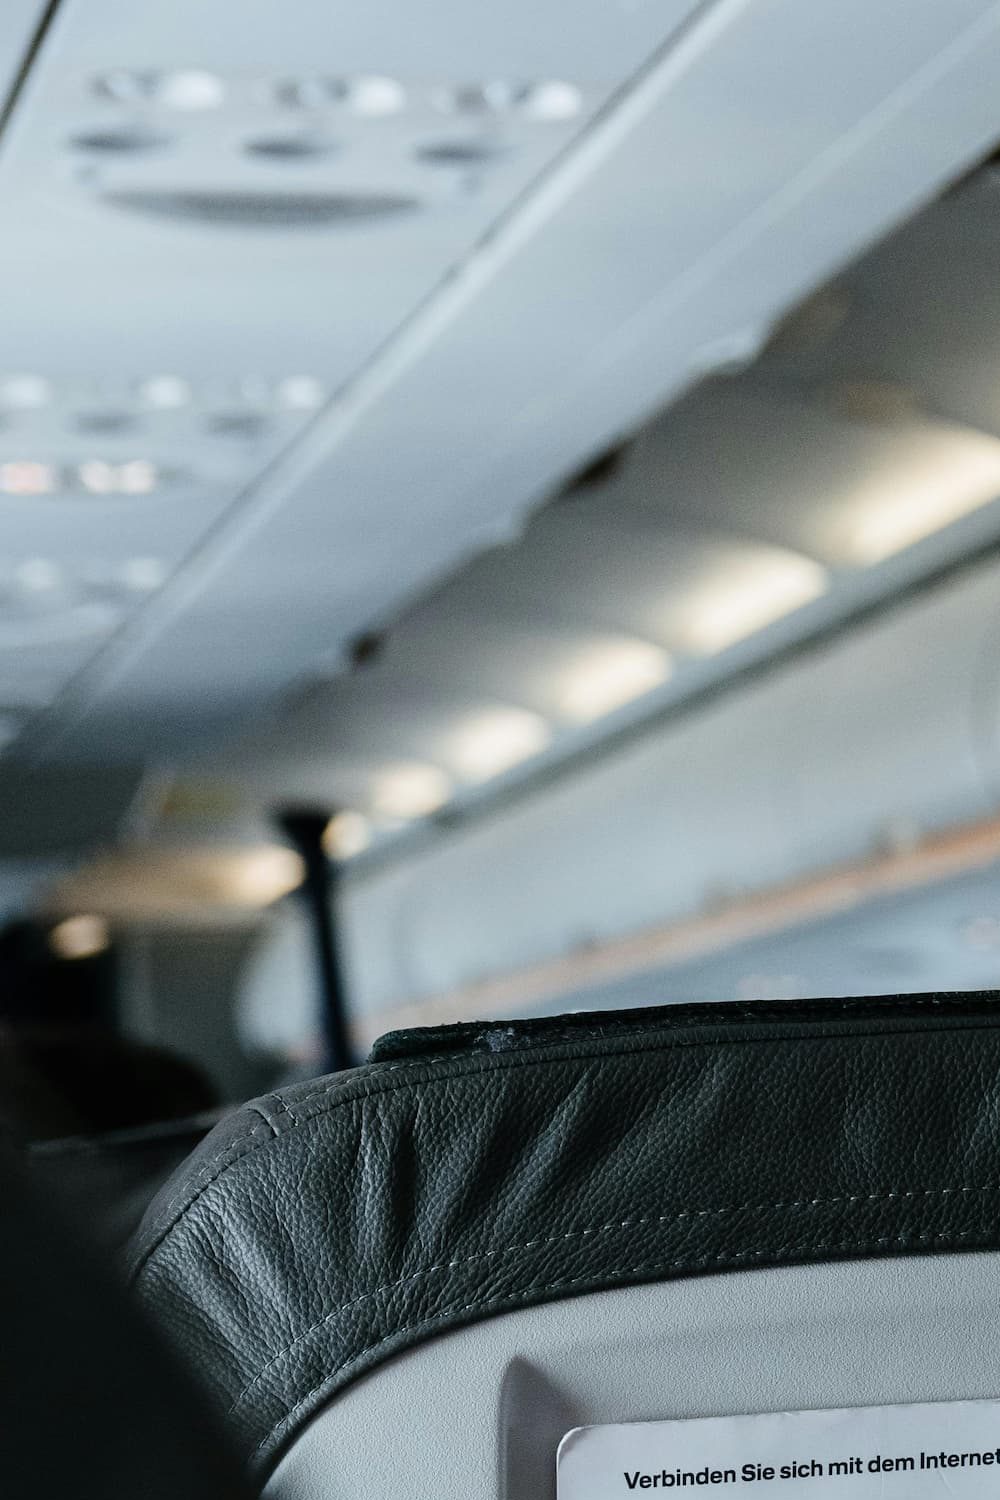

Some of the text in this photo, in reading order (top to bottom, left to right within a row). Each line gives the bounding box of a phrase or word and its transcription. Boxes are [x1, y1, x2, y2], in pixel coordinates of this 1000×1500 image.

[624, 1467, 736, 1489] Verbinden
[741, 1463, 775, 1482] Sie
[779, 1460, 823, 1479] sich
[828, 1457, 863, 1475] mit
[868, 1455, 915, 1472] dem
